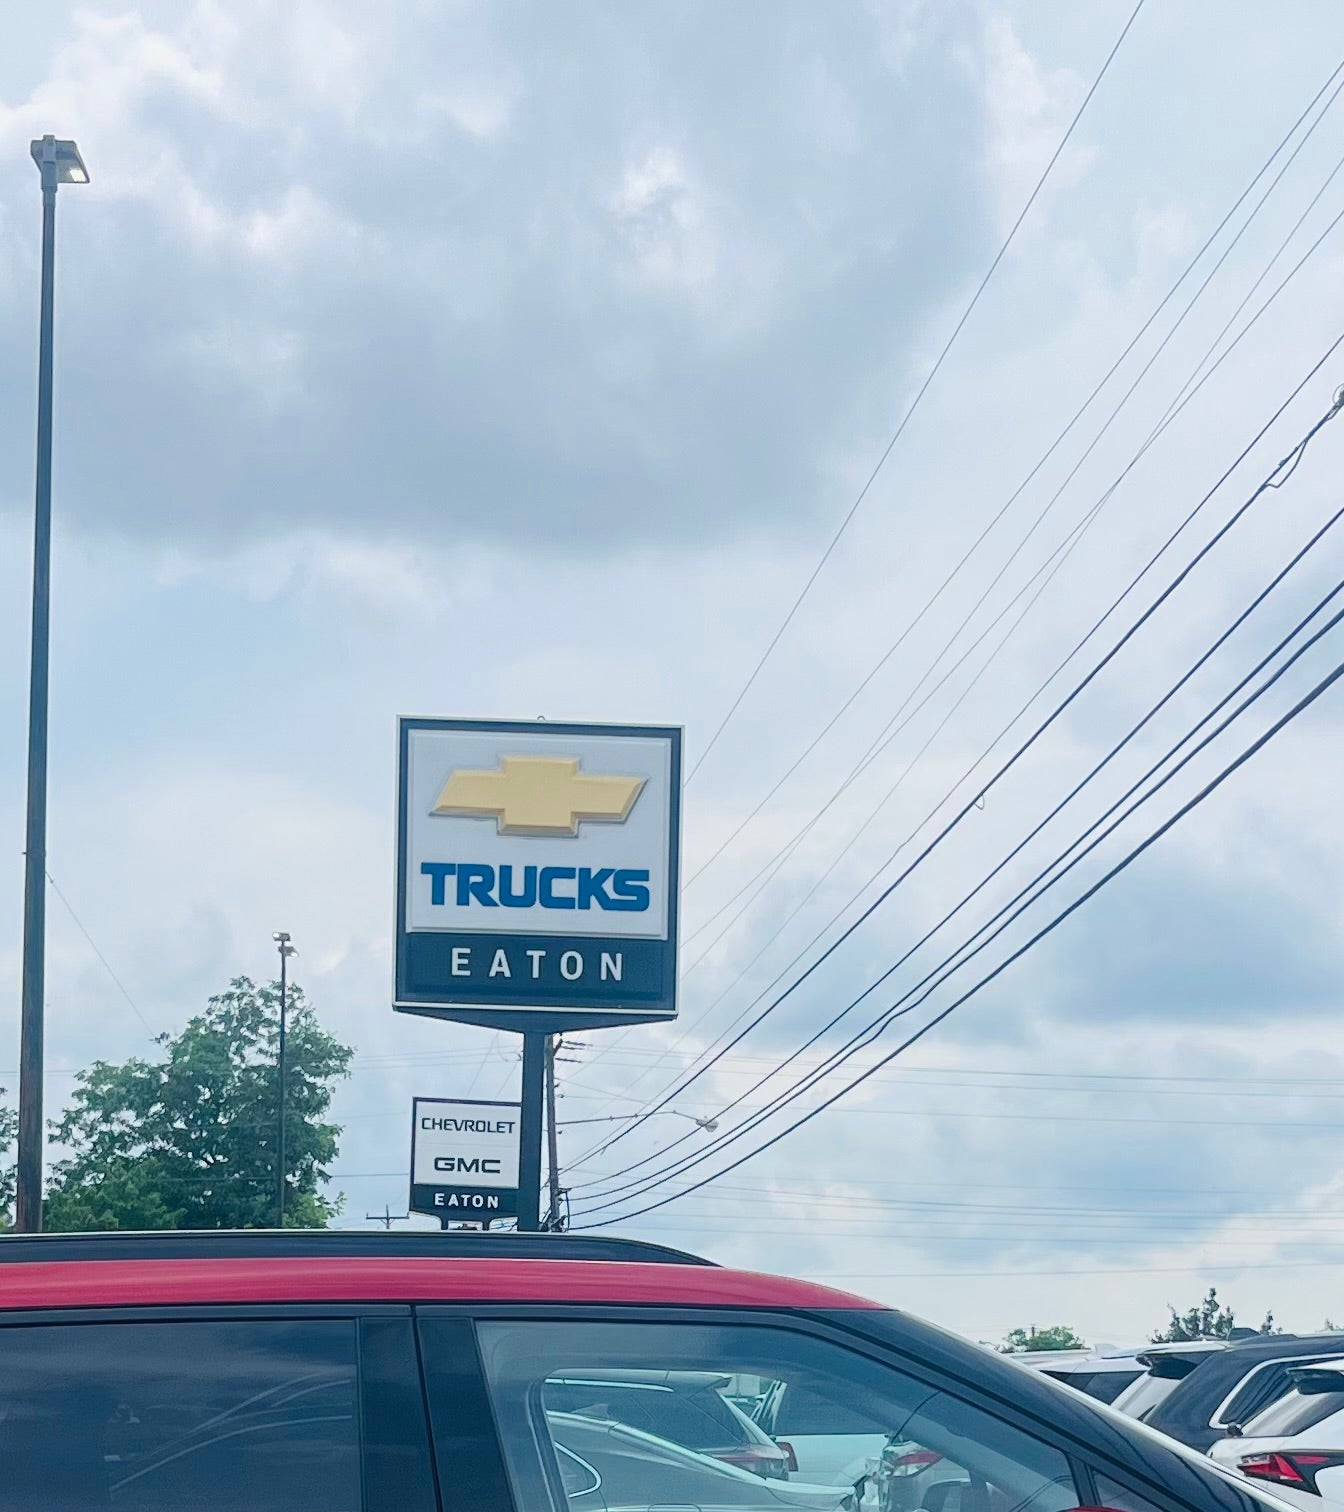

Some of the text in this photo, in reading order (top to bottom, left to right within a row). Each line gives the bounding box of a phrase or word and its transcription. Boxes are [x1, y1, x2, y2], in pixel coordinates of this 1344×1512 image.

[421, 862, 650, 912] TRUCKS
[451, 947, 623, 981] EATON
[421, 1117, 515, 1135] CHEVROLET
[434, 1156, 501, 1174] GMC
[434, 1192, 499, 1209] EATON
